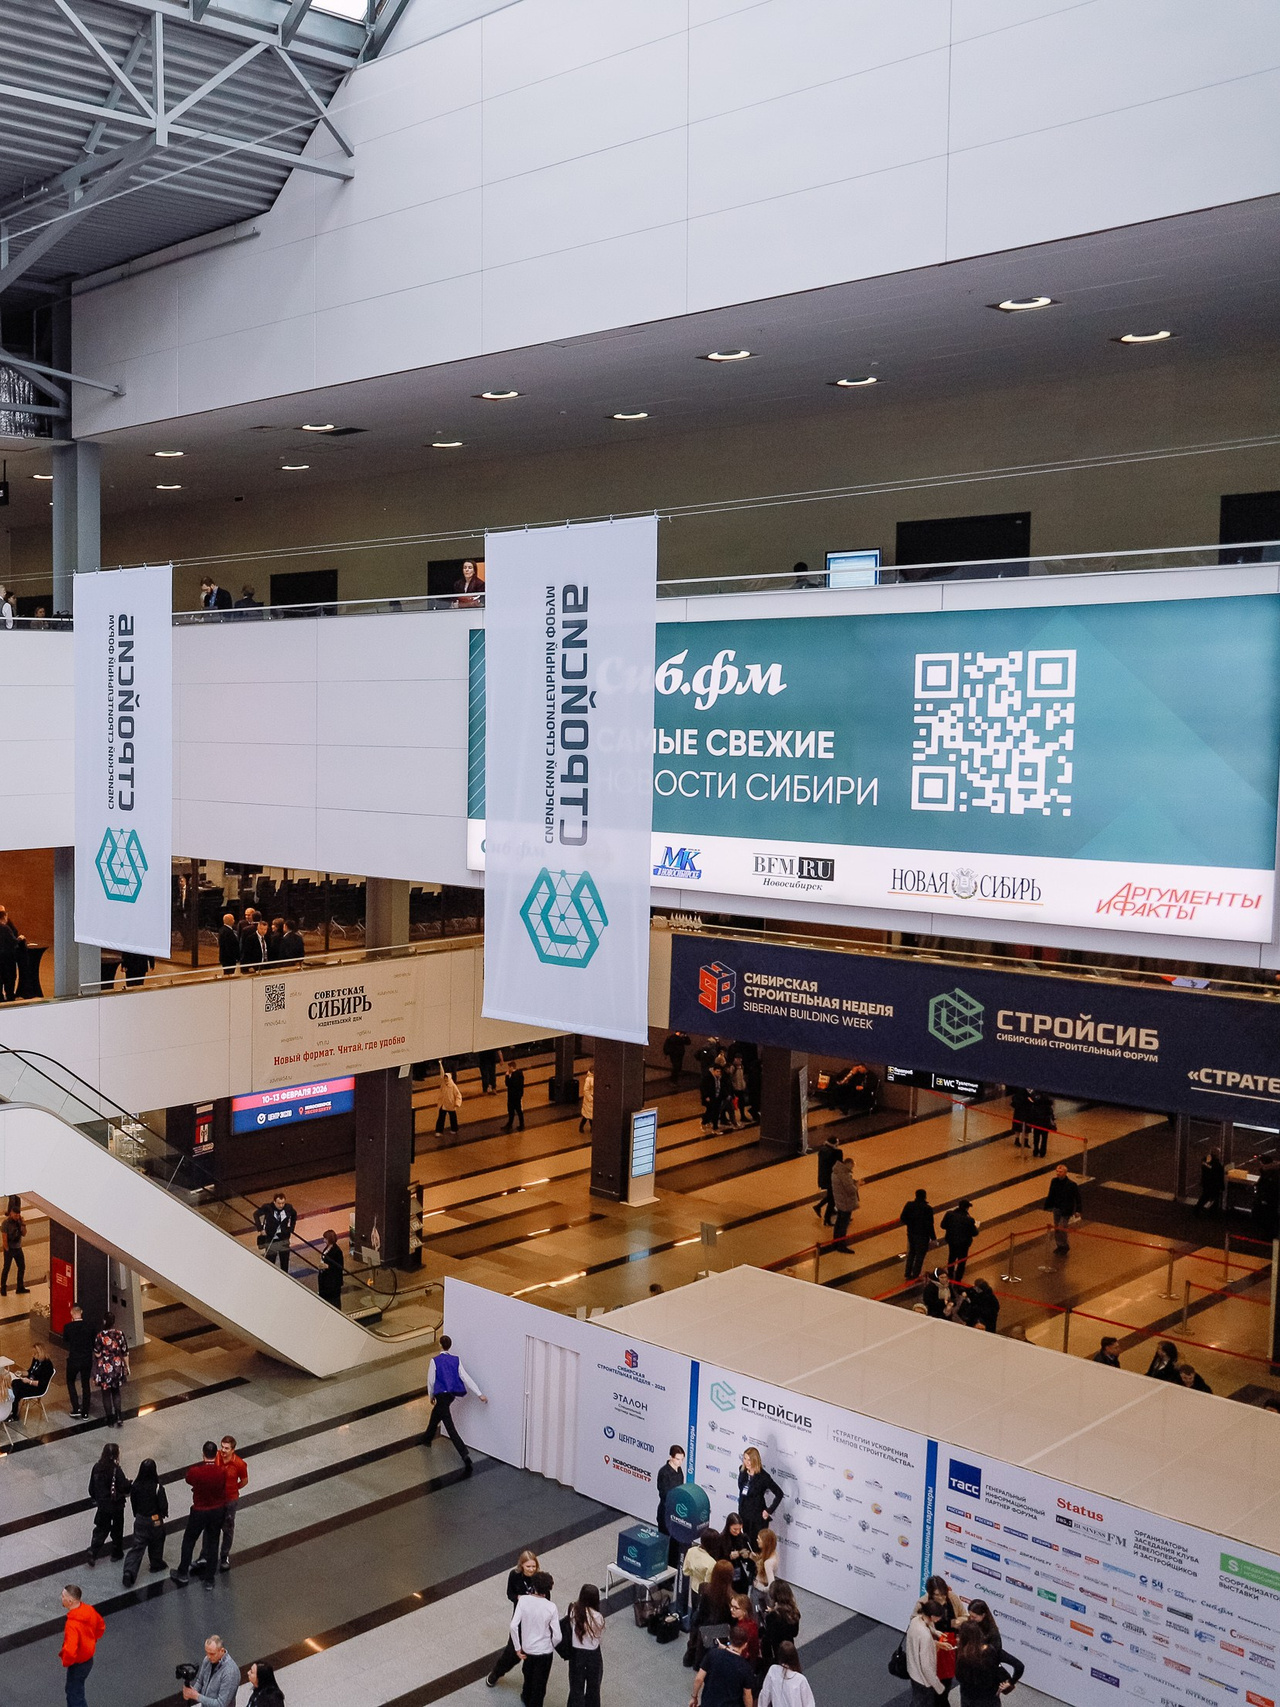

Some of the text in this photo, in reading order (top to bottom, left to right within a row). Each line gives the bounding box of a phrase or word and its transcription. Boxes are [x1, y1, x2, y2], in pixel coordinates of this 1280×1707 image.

[706, 729, 835, 759] СВЕЖИЕ
[746, 773, 878, 806] СИБИРИ
[763, 878, 823, 891] Новосибирск
[891, 868, 1042, 901] НОВАЯ СИБИРЬ
[314, 985, 365, 1000] СОВЕТСКАЯ
[743, 972, 818, 993] СИБИРСКАЯ
[308, 994, 372, 1020] СИБИРЬ
[743, 985, 894, 1018] СТРОИТЕЛЬНАЯ НЕДЕЛЯ
[743, 1001, 873, 1030] SIBERIAN BUILDING WEEK
[996, 1010, 1159, 1050] СТРОЙСИБ
[274, 1053, 301, 1066] Новый
[364, 1041, 378, 1051] где
[379, 1036, 406, 1049] удобно
[996, 1033, 1159, 1063] СИБИРСКИЙ СТРОИТЕЛЬНЫЙ ФОРУМ
[262, 1085, 328, 1104] 10-13 ФЕВРАЛЯ 2026
[597, 1363, 633, 1380] СТРОИТЕЛЬНАЯ
[617, 1365, 646, 1379] СИБИРСКАЯ
[613, 1392, 648, 1412] ЭТАЛОН
[741, 1395, 812, 1429] СТРОЙСИБ
[618, 1433, 655, 1454] ЦЕНТР ЭКСПО
[687, 1425, 697, 1475] Организаторы
[832, 1435, 859, 1450] ТЕМПОВ
[870, 1440, 909, 1459] УСКОРЕНИЯ
[985, 1484, 1027, 1504] ГЕНЕРАЛЬНЫЙ
[985, 1491, 1046, 1517] ИНФОРМАЦИОННЫЙ
[984, 1498, 1038, 1521] ПАРТНЕР ФОРУМА
[1056, 1497, 1104, 1522] Status
[1133, 1529, 1189, 1553] ОРГАНИЗАТОРЫ
[1134, 1536, 1200, 1564] ЗАСЕДАНИЯ КЛУБА
[1133, 1543, 1183, 1565] ДЕВЕЛОПЕРОВ
[1140, 1553, 1198, 1578] ЗАСТРОЙЩИКОВ
[1219, 1582, 1260, 1601] ВЫСТАВКИ
